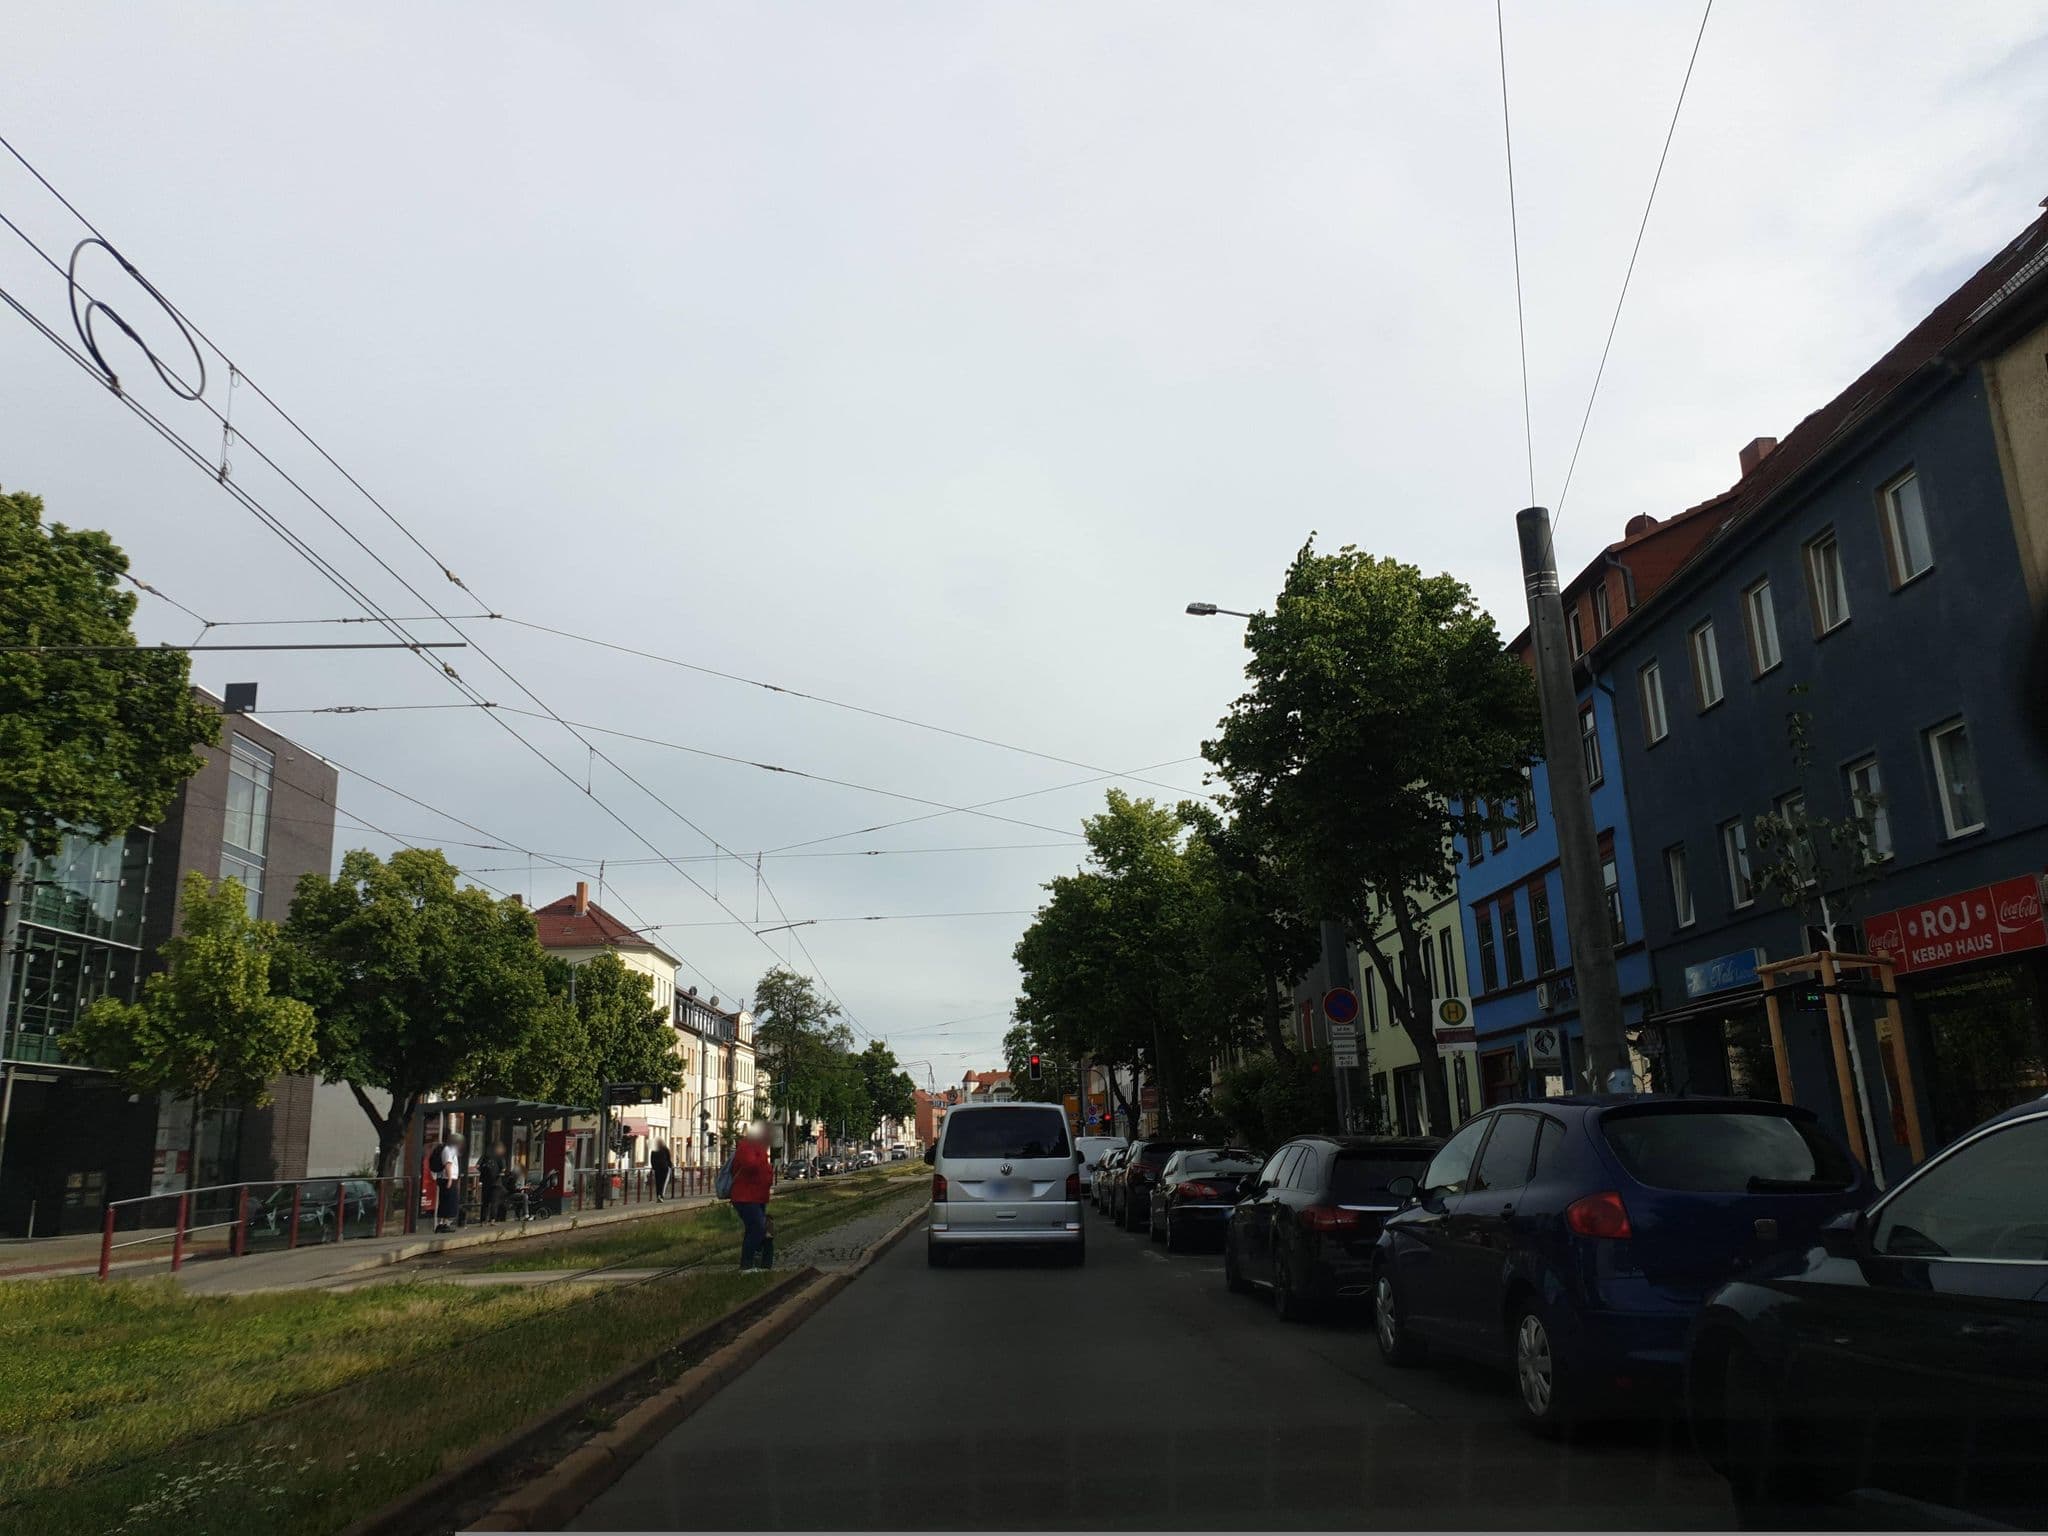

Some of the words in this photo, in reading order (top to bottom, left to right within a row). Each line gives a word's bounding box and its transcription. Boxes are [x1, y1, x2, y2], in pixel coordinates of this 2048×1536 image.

[1921, 901, 1970, 938] ROJ
[1912, 943, 1953, 965] KEBAP
[1956, 933, 1994, 955] HAUS
